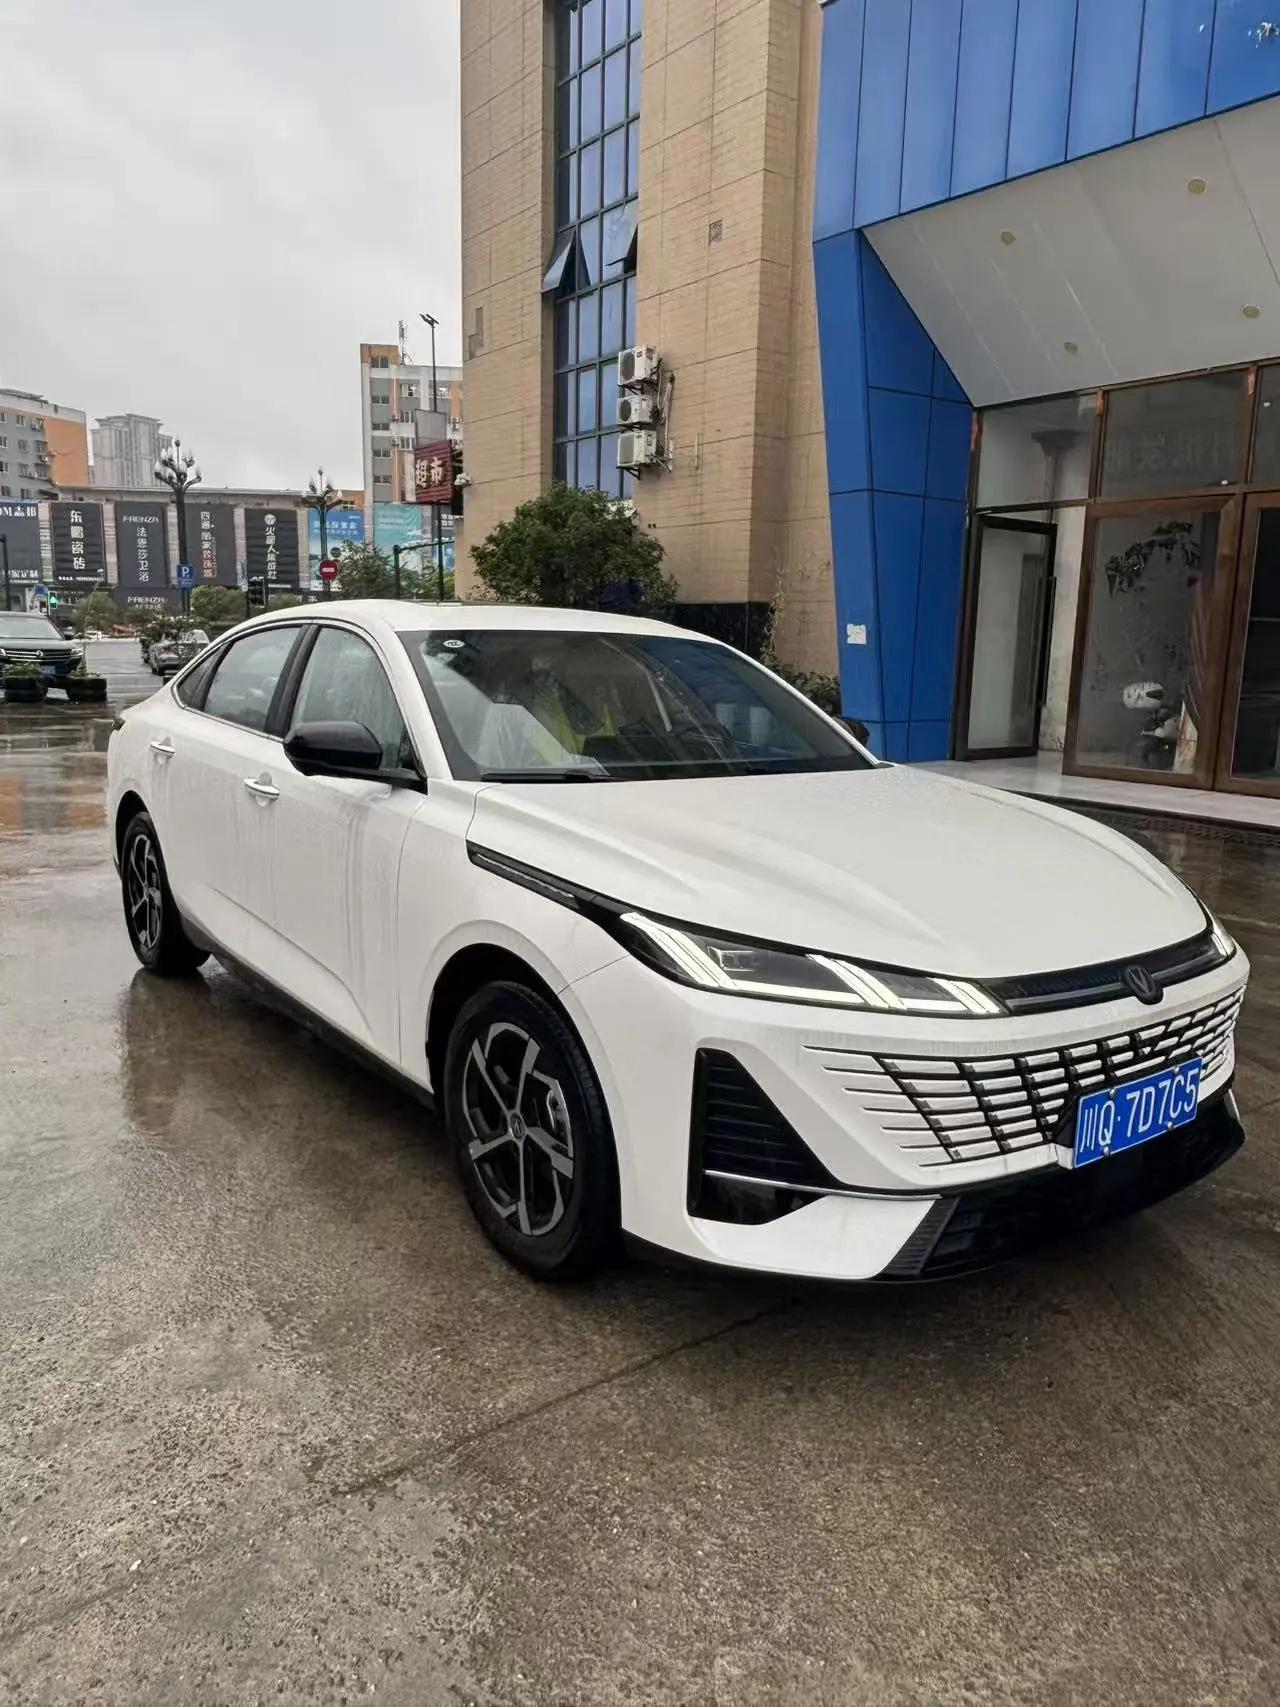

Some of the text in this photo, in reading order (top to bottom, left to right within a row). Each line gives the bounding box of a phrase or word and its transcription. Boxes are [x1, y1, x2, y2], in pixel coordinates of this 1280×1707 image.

[416, 456, 446, 488] 超市
[70, 510, 86, 569] 东鹏瓷砖
[136, 527, 150, 582] 法恩莎卫浴
[265, 526, 278, 580] 火星人集成灶
[182, 566, 189, 577] P
